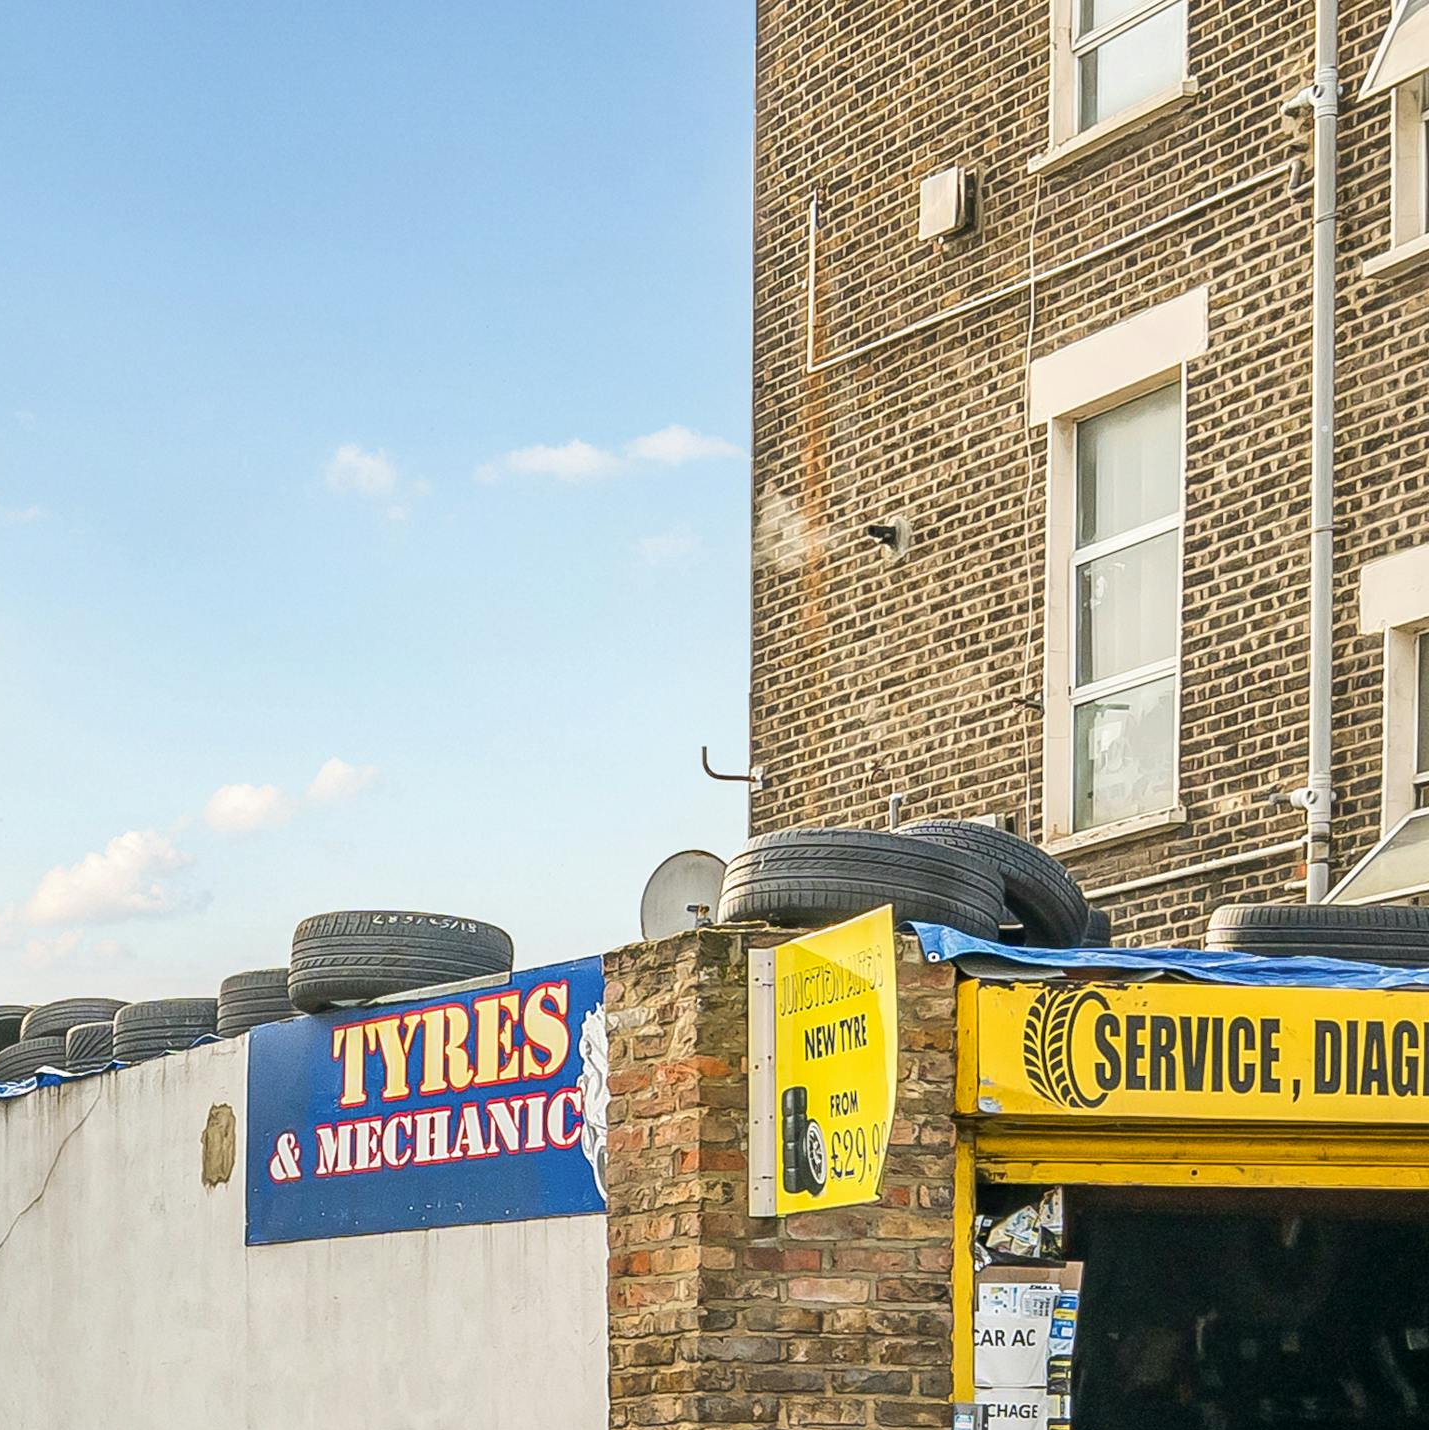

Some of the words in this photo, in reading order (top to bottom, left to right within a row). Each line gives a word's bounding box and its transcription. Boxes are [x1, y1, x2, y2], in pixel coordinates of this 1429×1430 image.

[332, 979, 571, 1109] TYRES
[804, 1022, 837, 1062] NEW
[839, 1013, 868, 1053] TYRE
[830, 1089, 859, 1118] FROM
[269, 1131, 301, 1184] &
[315, 1086, 584, 1177] MECHANIC
[974, 1329, 1006, 1347] CAR
[1011, 1329, 1036, 1347] AC
